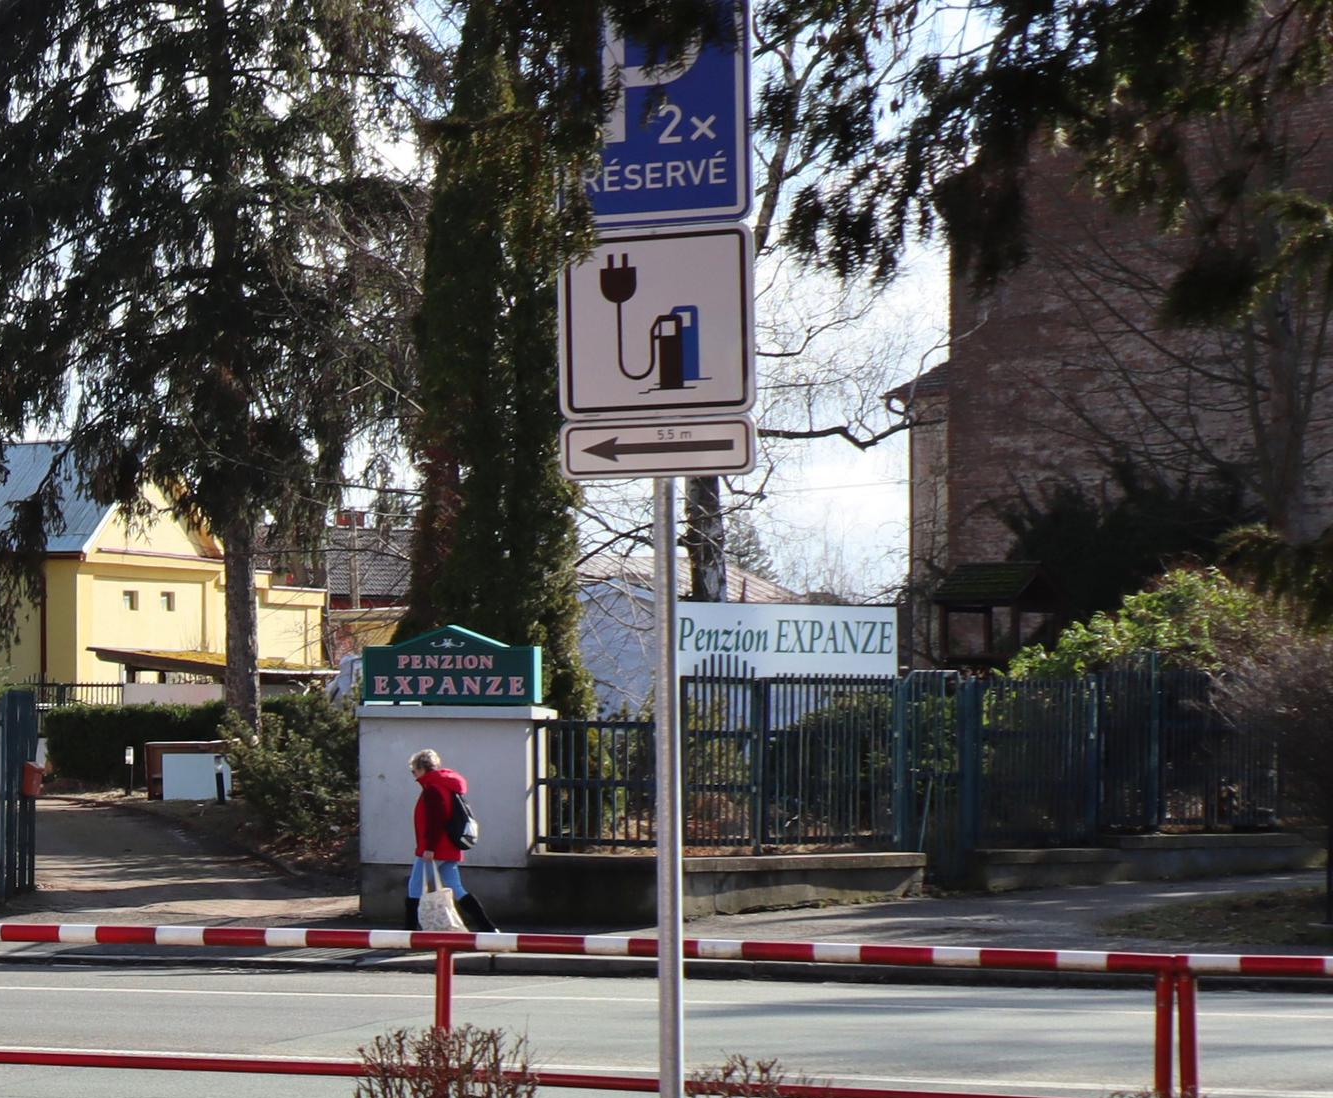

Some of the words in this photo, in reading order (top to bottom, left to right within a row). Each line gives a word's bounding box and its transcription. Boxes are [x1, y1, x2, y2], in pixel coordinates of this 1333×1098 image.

[680, 431, 692, 439] m
[678, 616, 769, 653] Penzion
[774, 619, 894, 655] EXPANZE
[397, 655, 494, 669] PENZION
[373, 676, 525, 696] EXPANZE
